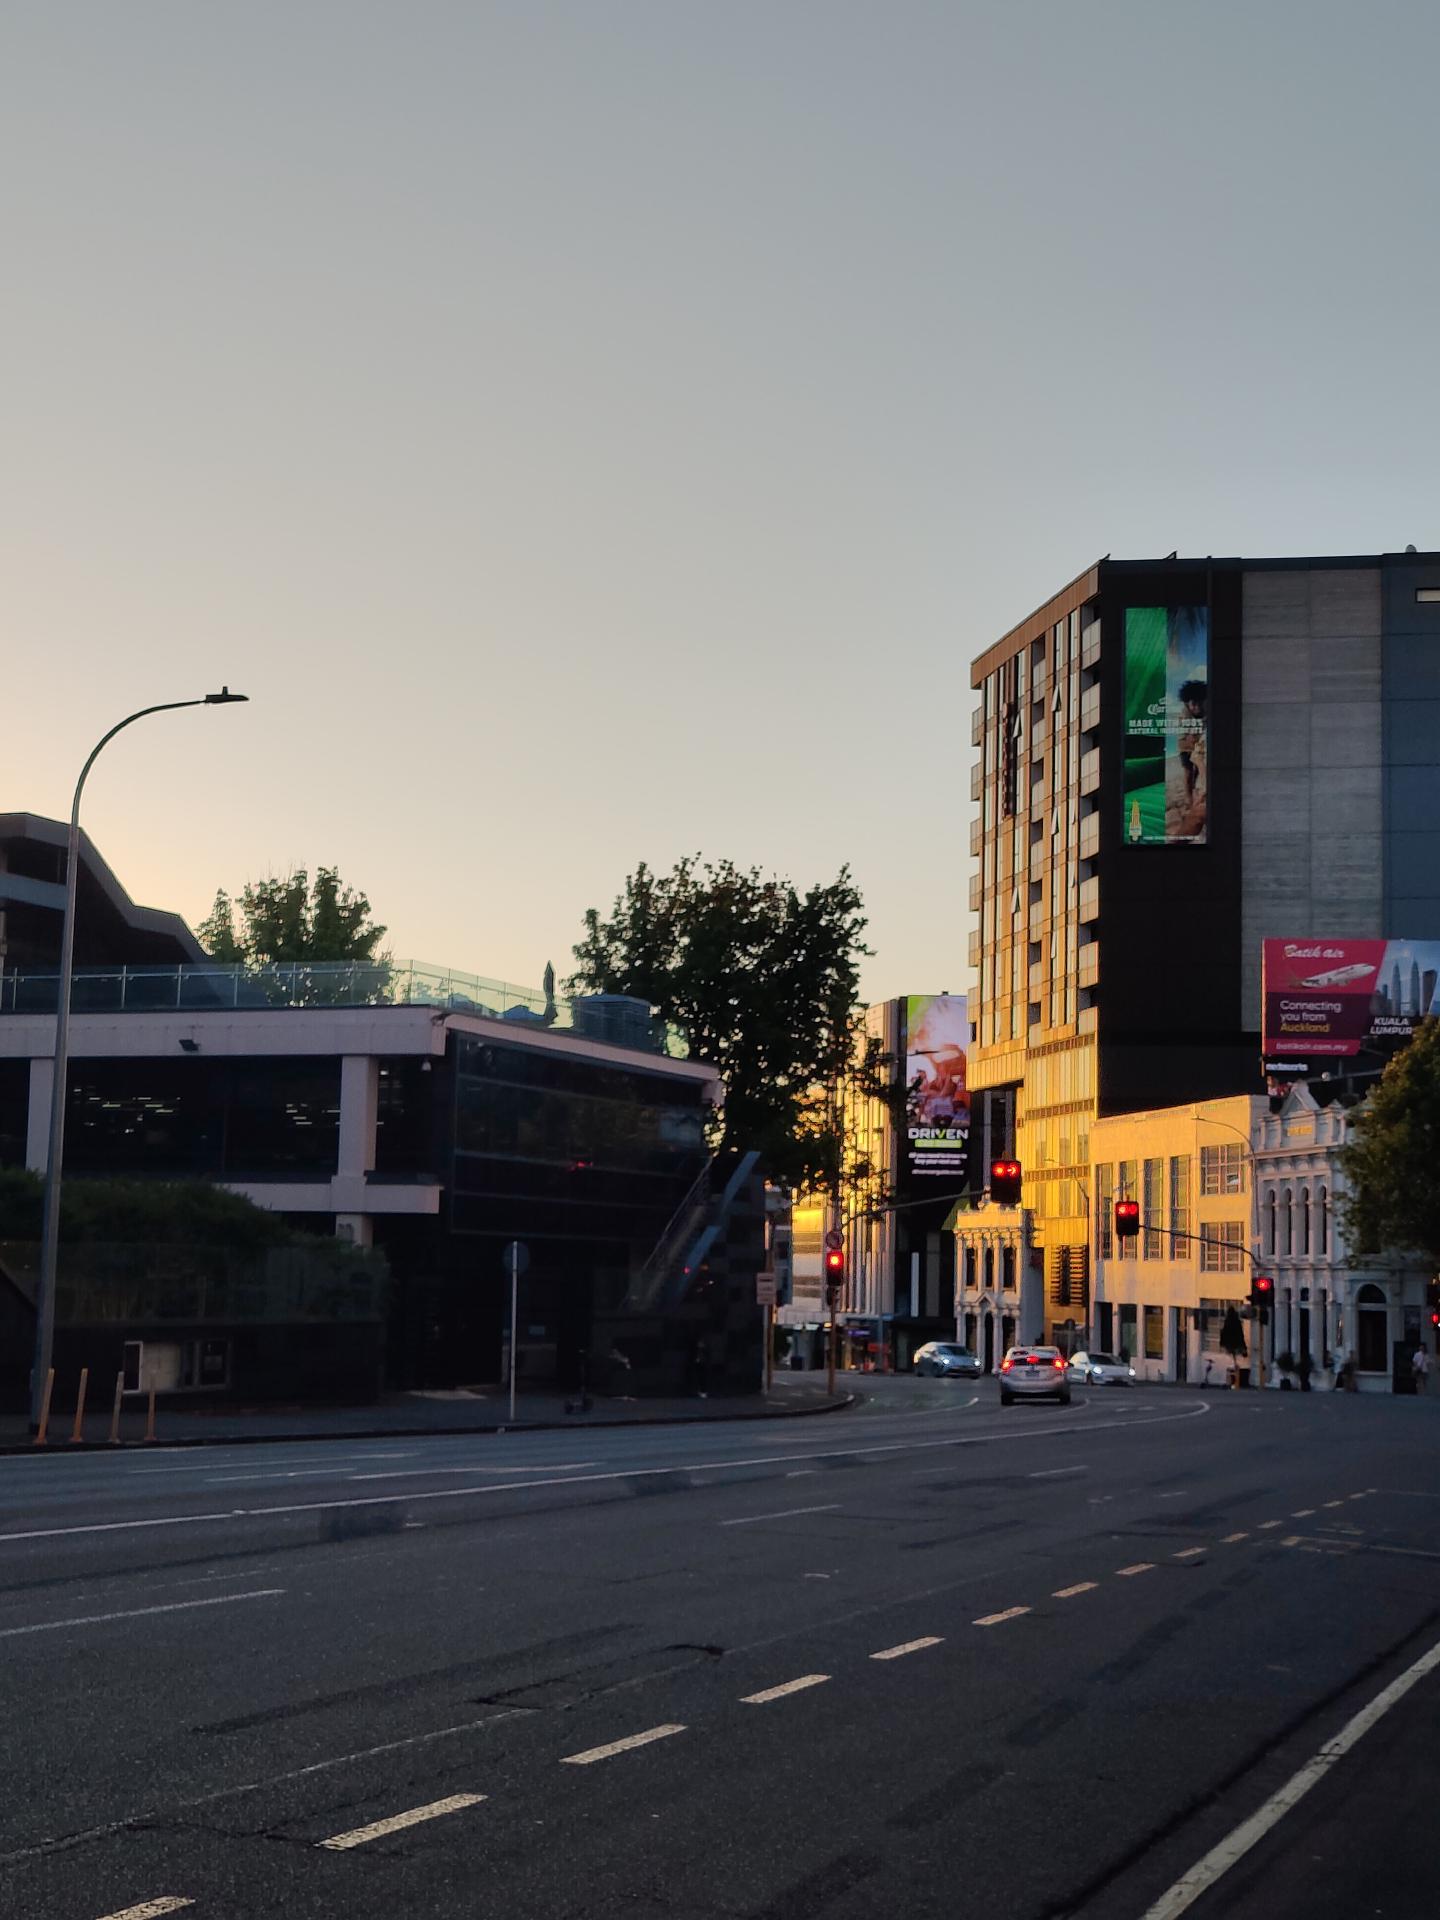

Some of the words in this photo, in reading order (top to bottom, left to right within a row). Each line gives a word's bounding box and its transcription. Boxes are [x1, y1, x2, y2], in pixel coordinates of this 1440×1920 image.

[1128, 719, 1152, 727] MADE
[1284, 944, 1319, 958] Batik
[1323, 946, 1345, 958] air
[1280, 1000, 1341, 1013] Connecting
[1280, 1013, 1300, 1022] you
[1302, 1012, 1326, 1021] from
[1374, 1017, 1410, 1026] KUALA
[1280, 1023, 1330, 1033] Auckland
[1370, 1026, 1413, 1035] LUMPUR
[908, 1128, 968, 1139] DRIVEN
